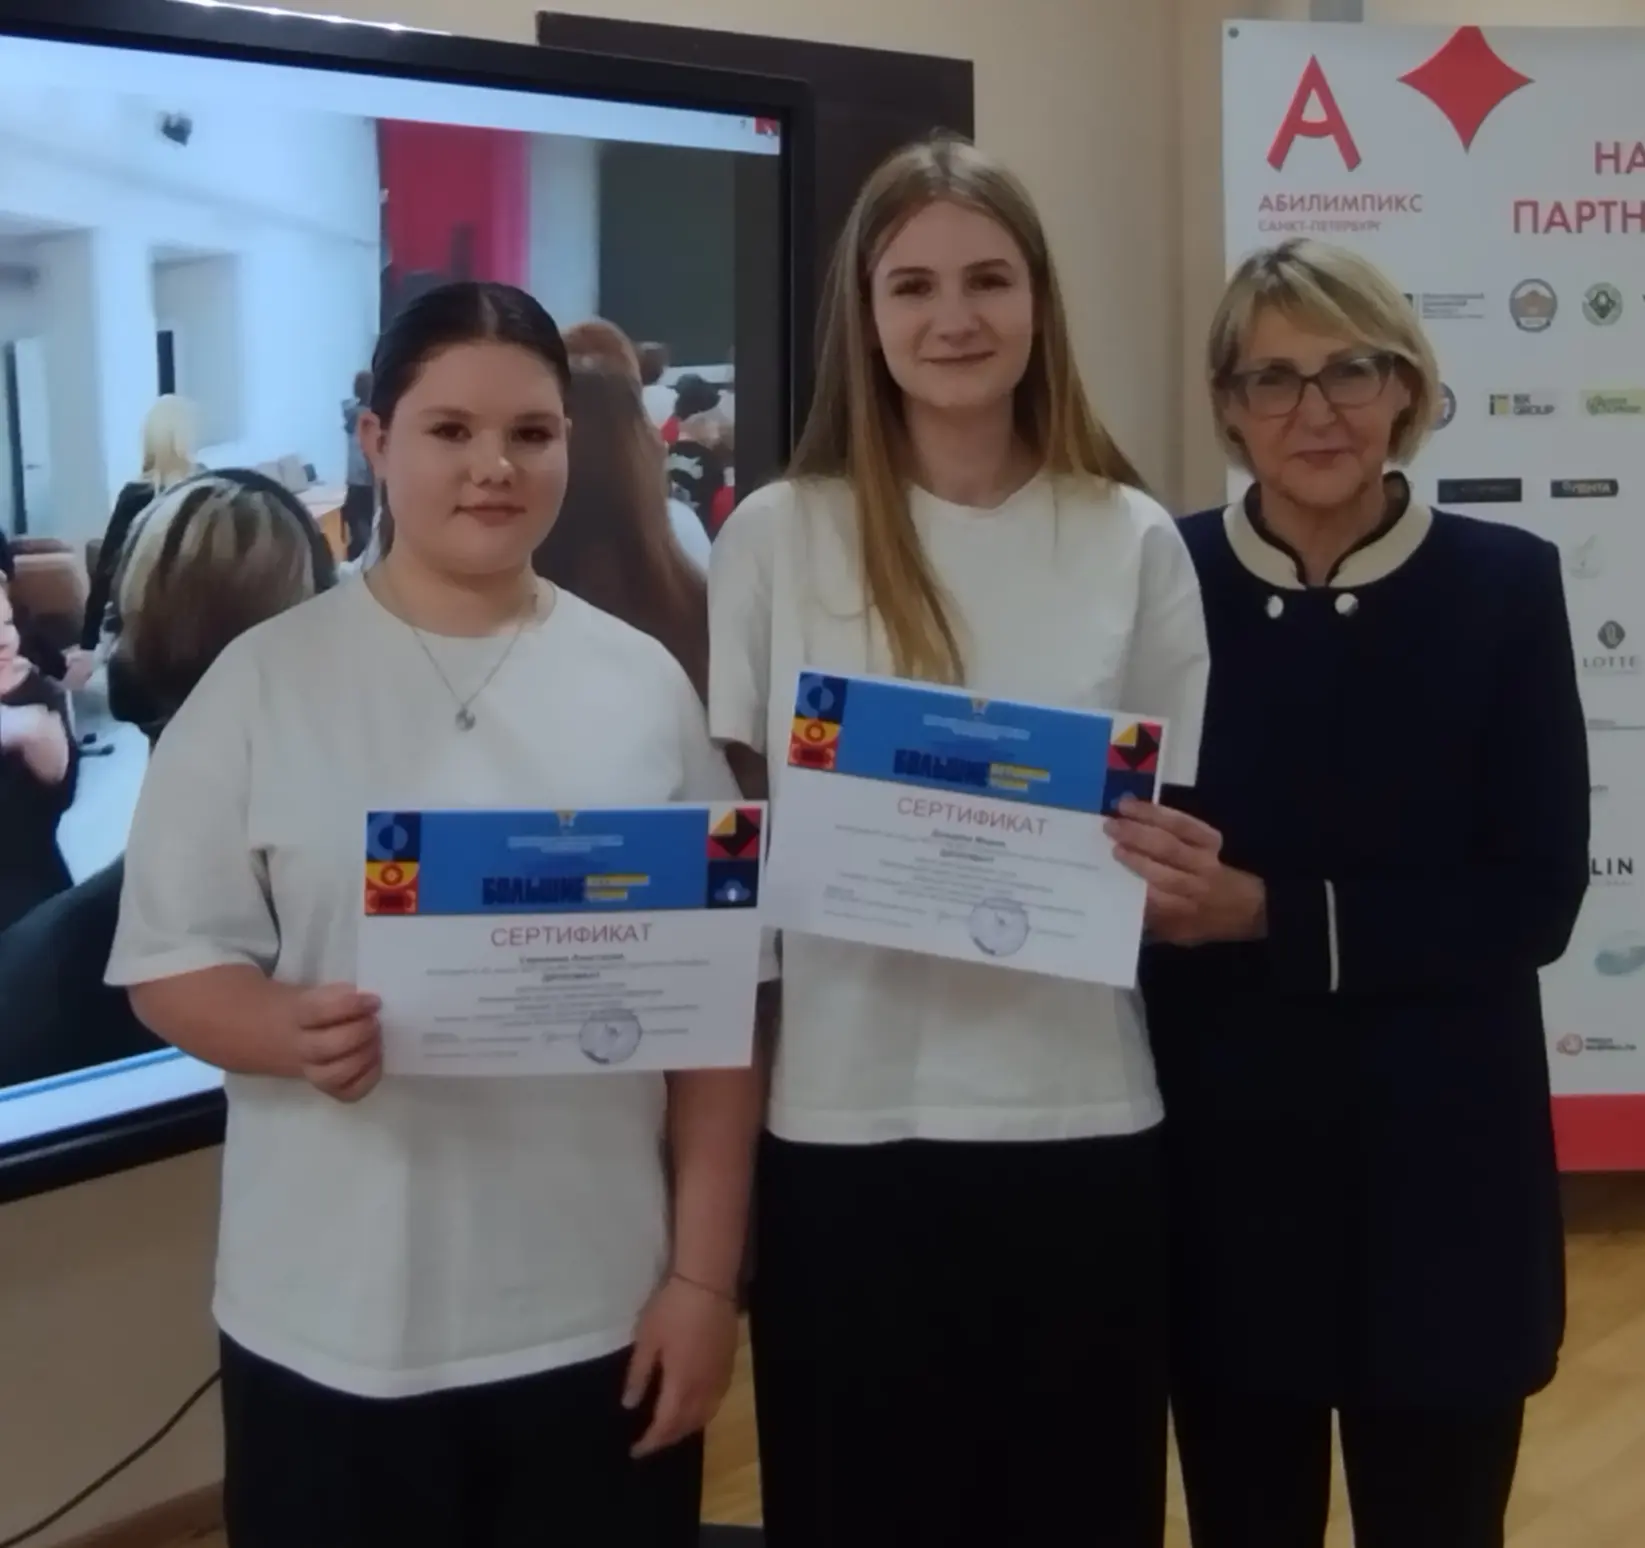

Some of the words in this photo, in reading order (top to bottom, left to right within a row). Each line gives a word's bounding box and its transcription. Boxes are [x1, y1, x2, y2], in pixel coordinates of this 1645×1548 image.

[1258, 193, 1424, 213] АБИЛИМПИКС
[1583, 655, 1636, 669] LOTTE
[897, 796, 1048, 836] СЕРТИФИКАТ
[490, 922, 653, 947] СЕРТИФИКАТ
